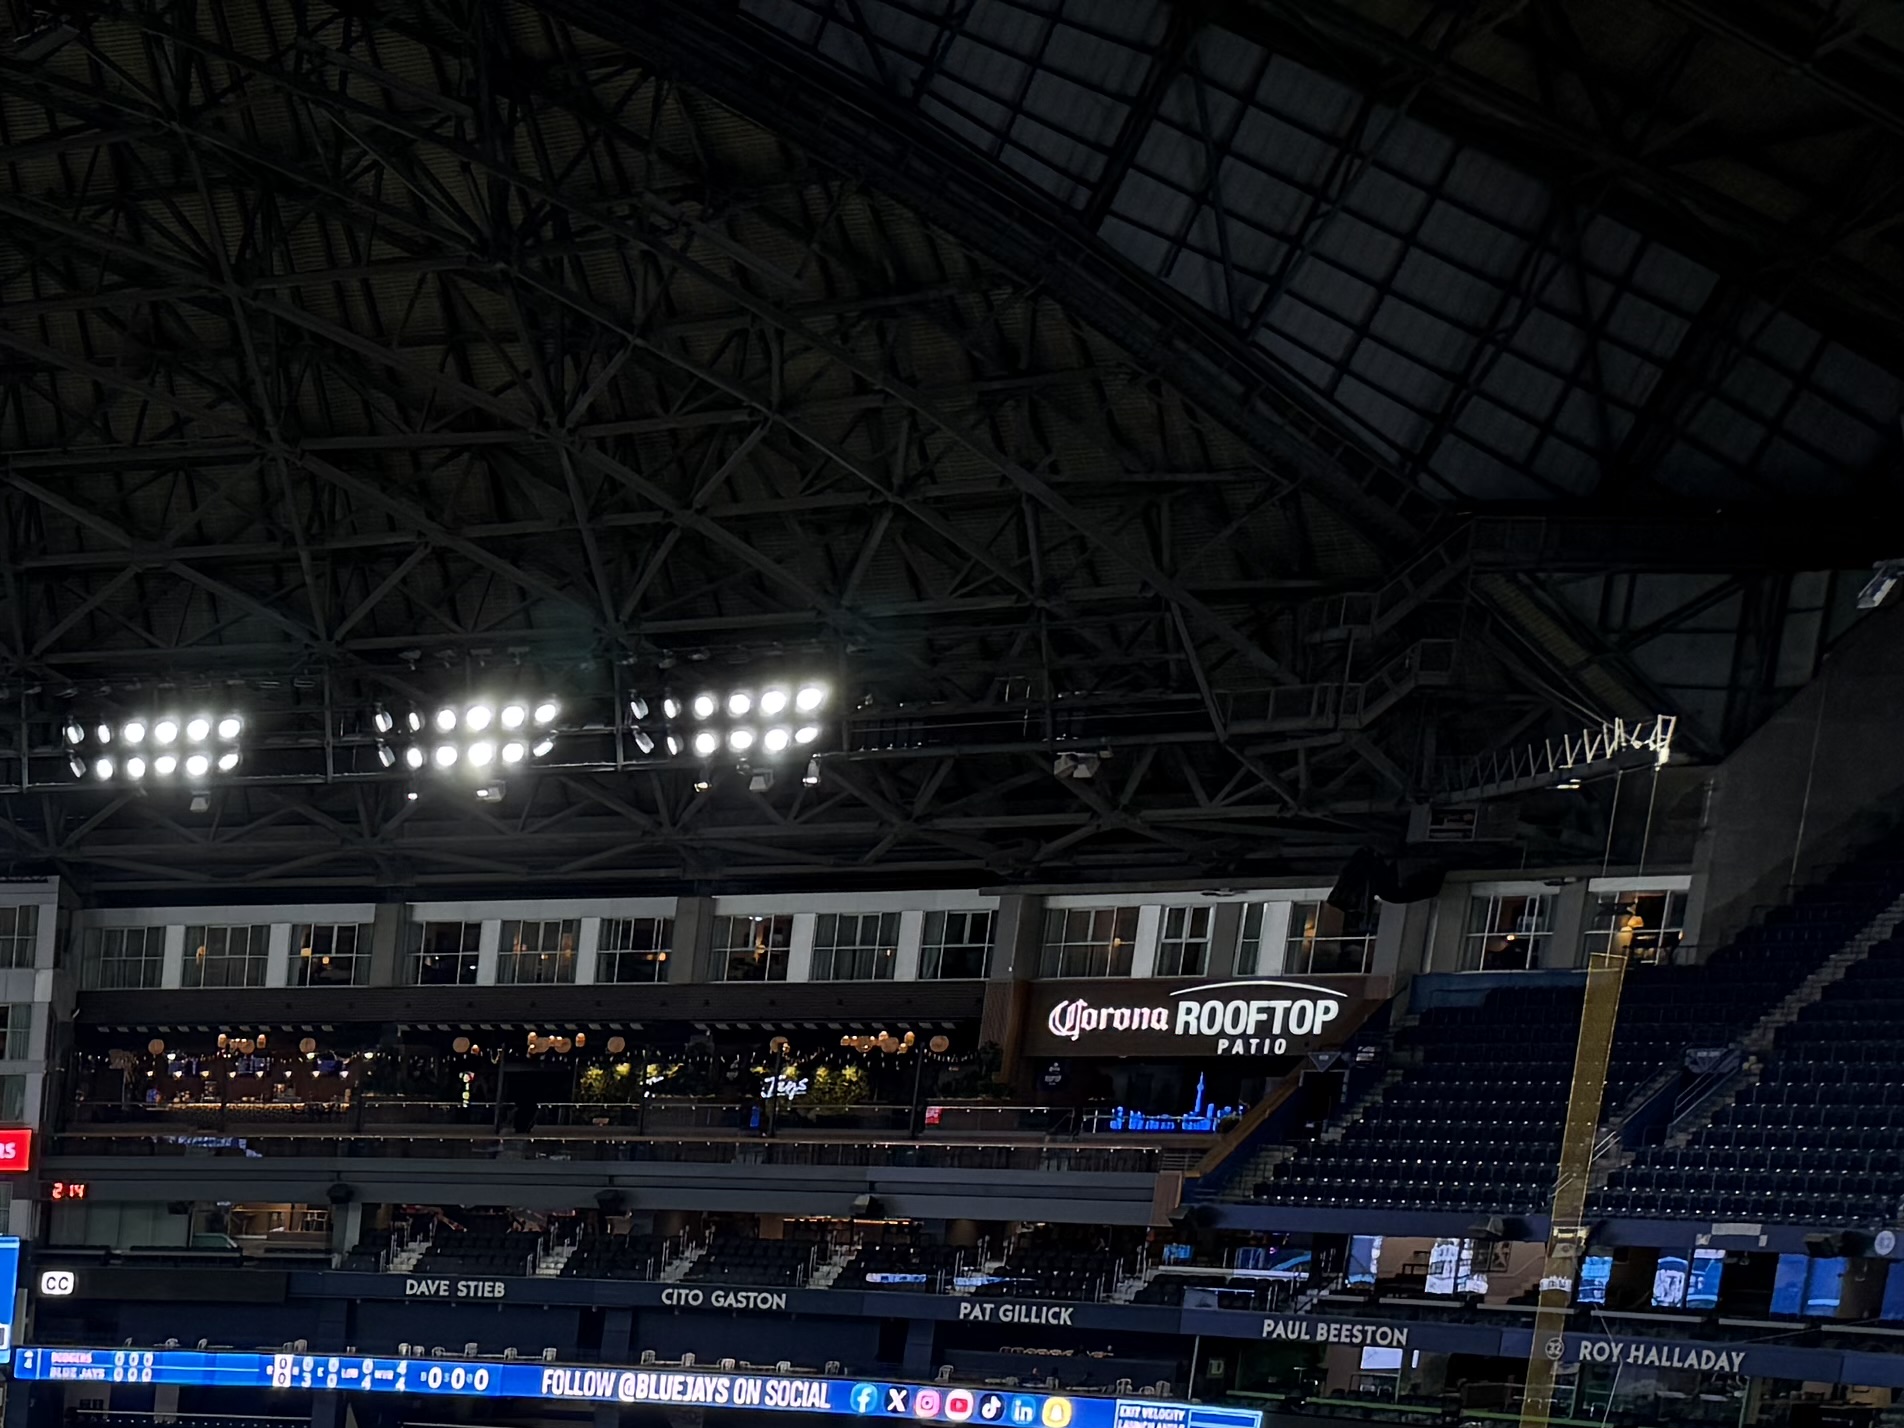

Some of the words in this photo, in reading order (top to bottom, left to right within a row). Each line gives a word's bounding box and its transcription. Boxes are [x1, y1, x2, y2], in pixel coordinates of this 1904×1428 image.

[1048, 999, 1168, 1041] Corona
[1175, 1000, 1339, 1035] ROOFTOP
[1217, 1039, 1286, 1054] PATIO
[405, 1280, 451, 1296] DAVE
[457, 1282, 505, 1298] STIEB
[662, 1288, 703, 1307] CITO
[710, 1291, 787, 1311] GASTON
[959, 1303, 994, 1321] PAT
[998, 1304, 1073, 1325] GILLICK
[1262, 1320, 1310, 1340] PAUL
[1316, 1322, 1408, 1346] BEESTON
[1578, 1342, 1622, 1363] ROY
[1626, 1343, 1746, 1373] HALLADAY
[541, 1370, 616, 1398] FOLLOW
[618, 1375, 728, 1403] @BLUEJAYS
[733, 1380, 760, 1404] ON
[764, 1381, 831, 1409] SOCIAL
